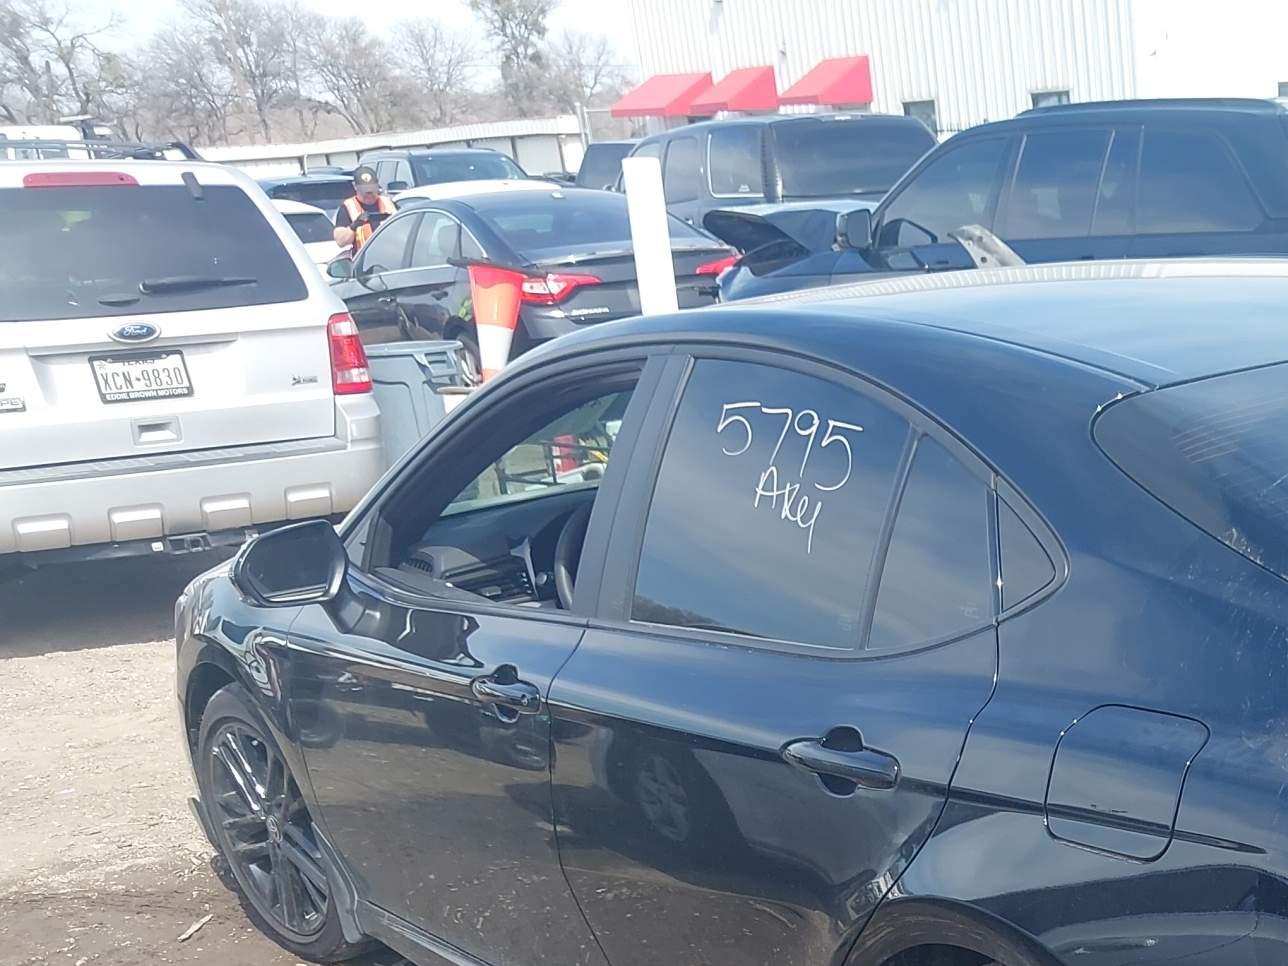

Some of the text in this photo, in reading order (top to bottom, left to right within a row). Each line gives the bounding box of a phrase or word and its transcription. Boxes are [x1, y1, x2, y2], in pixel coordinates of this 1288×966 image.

[105, 387, 188, 401] EDDIE BROWN MOTORS
[717, 401, 864, 491] 5795
